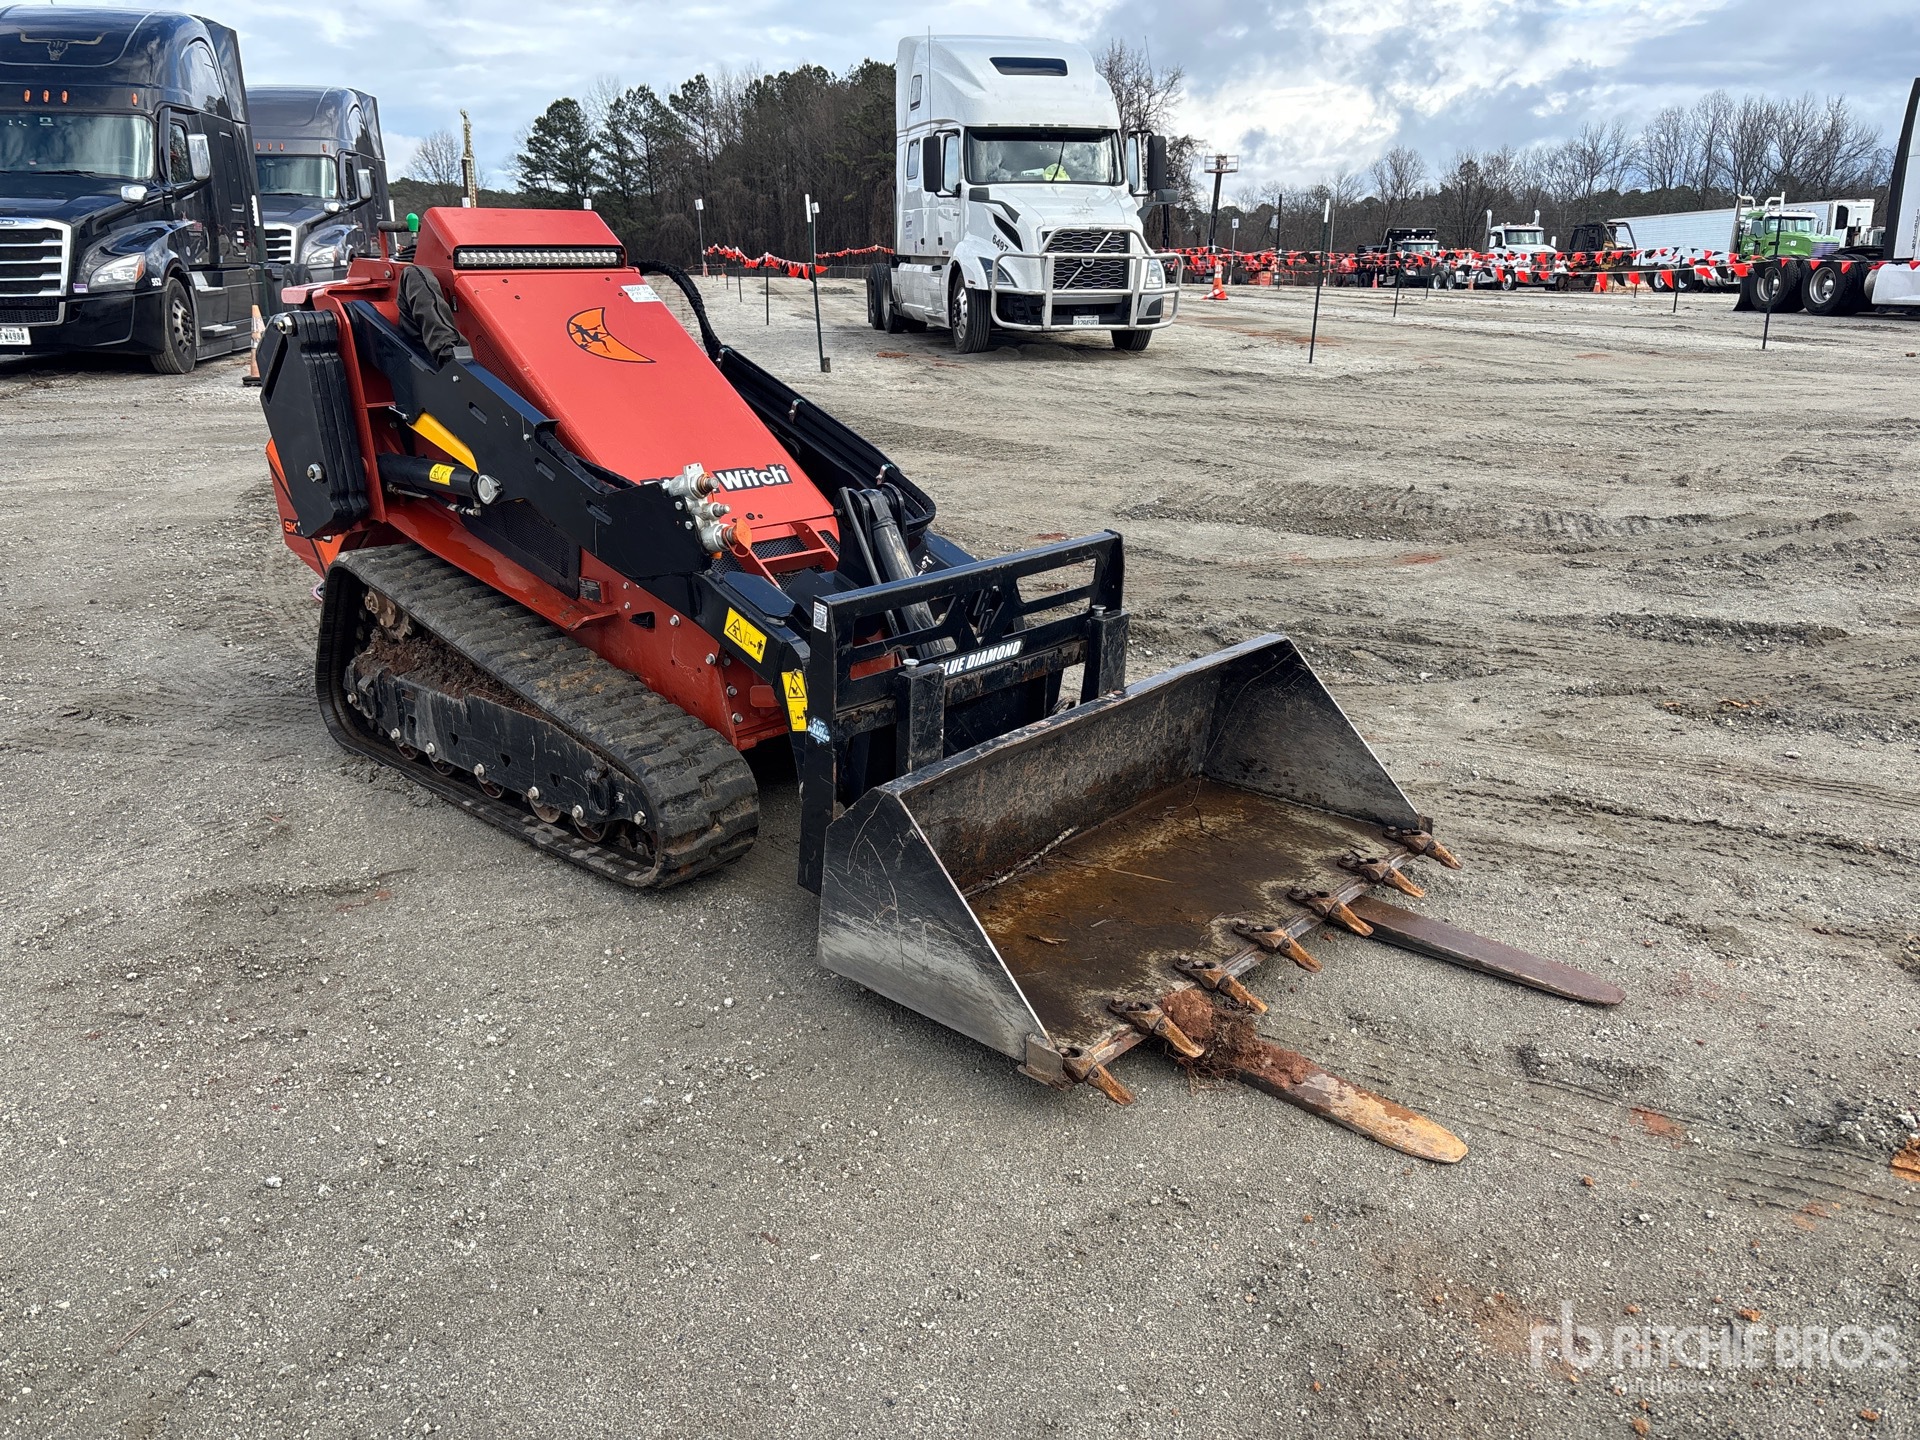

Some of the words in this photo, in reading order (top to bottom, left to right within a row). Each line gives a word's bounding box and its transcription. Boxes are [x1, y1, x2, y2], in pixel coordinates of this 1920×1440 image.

[992, 234, 1009, 252] 6497
[151, 278, 162, 286] 552
[716, 466, 789, 490] Witch
[966, 640, 1022, 669] DIAMOND
